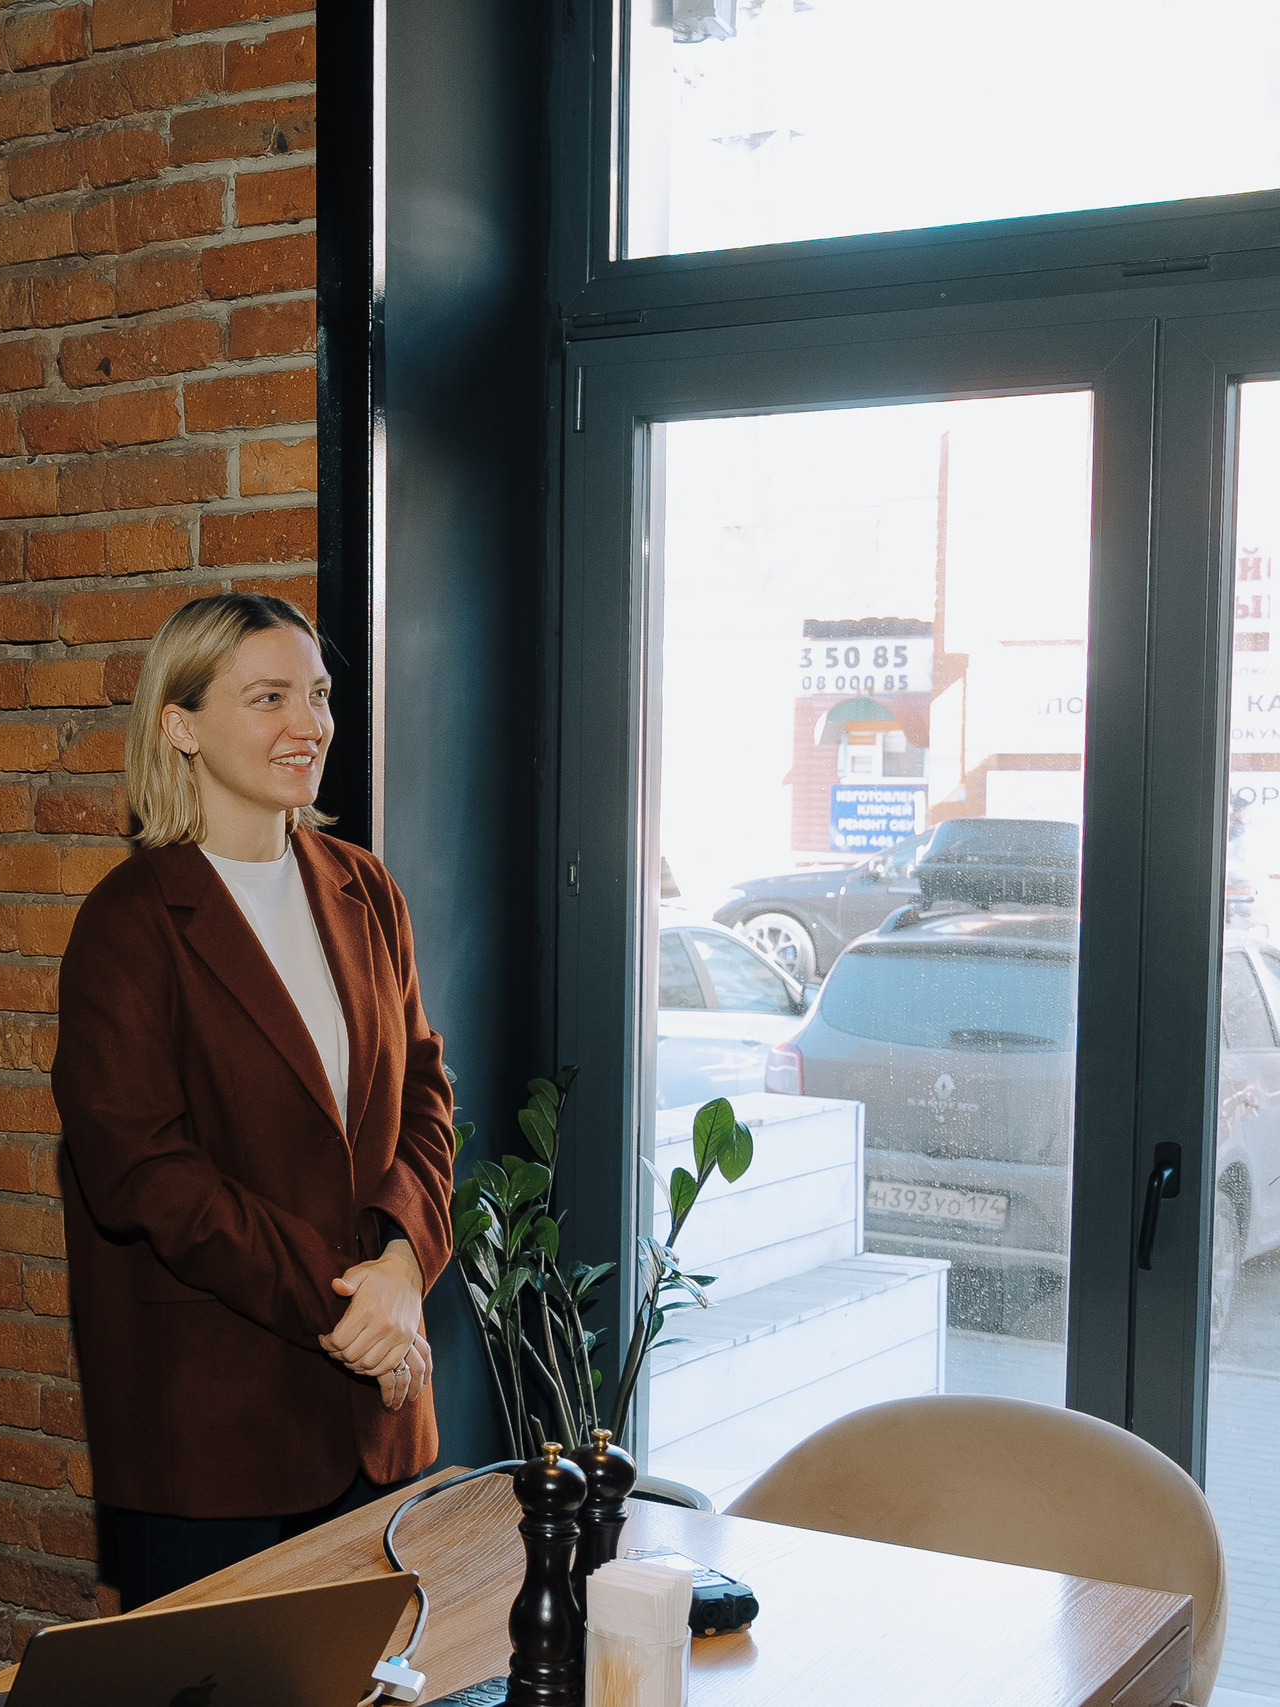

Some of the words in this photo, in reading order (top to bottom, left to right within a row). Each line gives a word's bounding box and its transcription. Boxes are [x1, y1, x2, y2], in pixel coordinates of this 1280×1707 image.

[825, 646, 861, 669] 50
[873, 645, 908, 669] 85
[883, 674, 909, 690] 85
